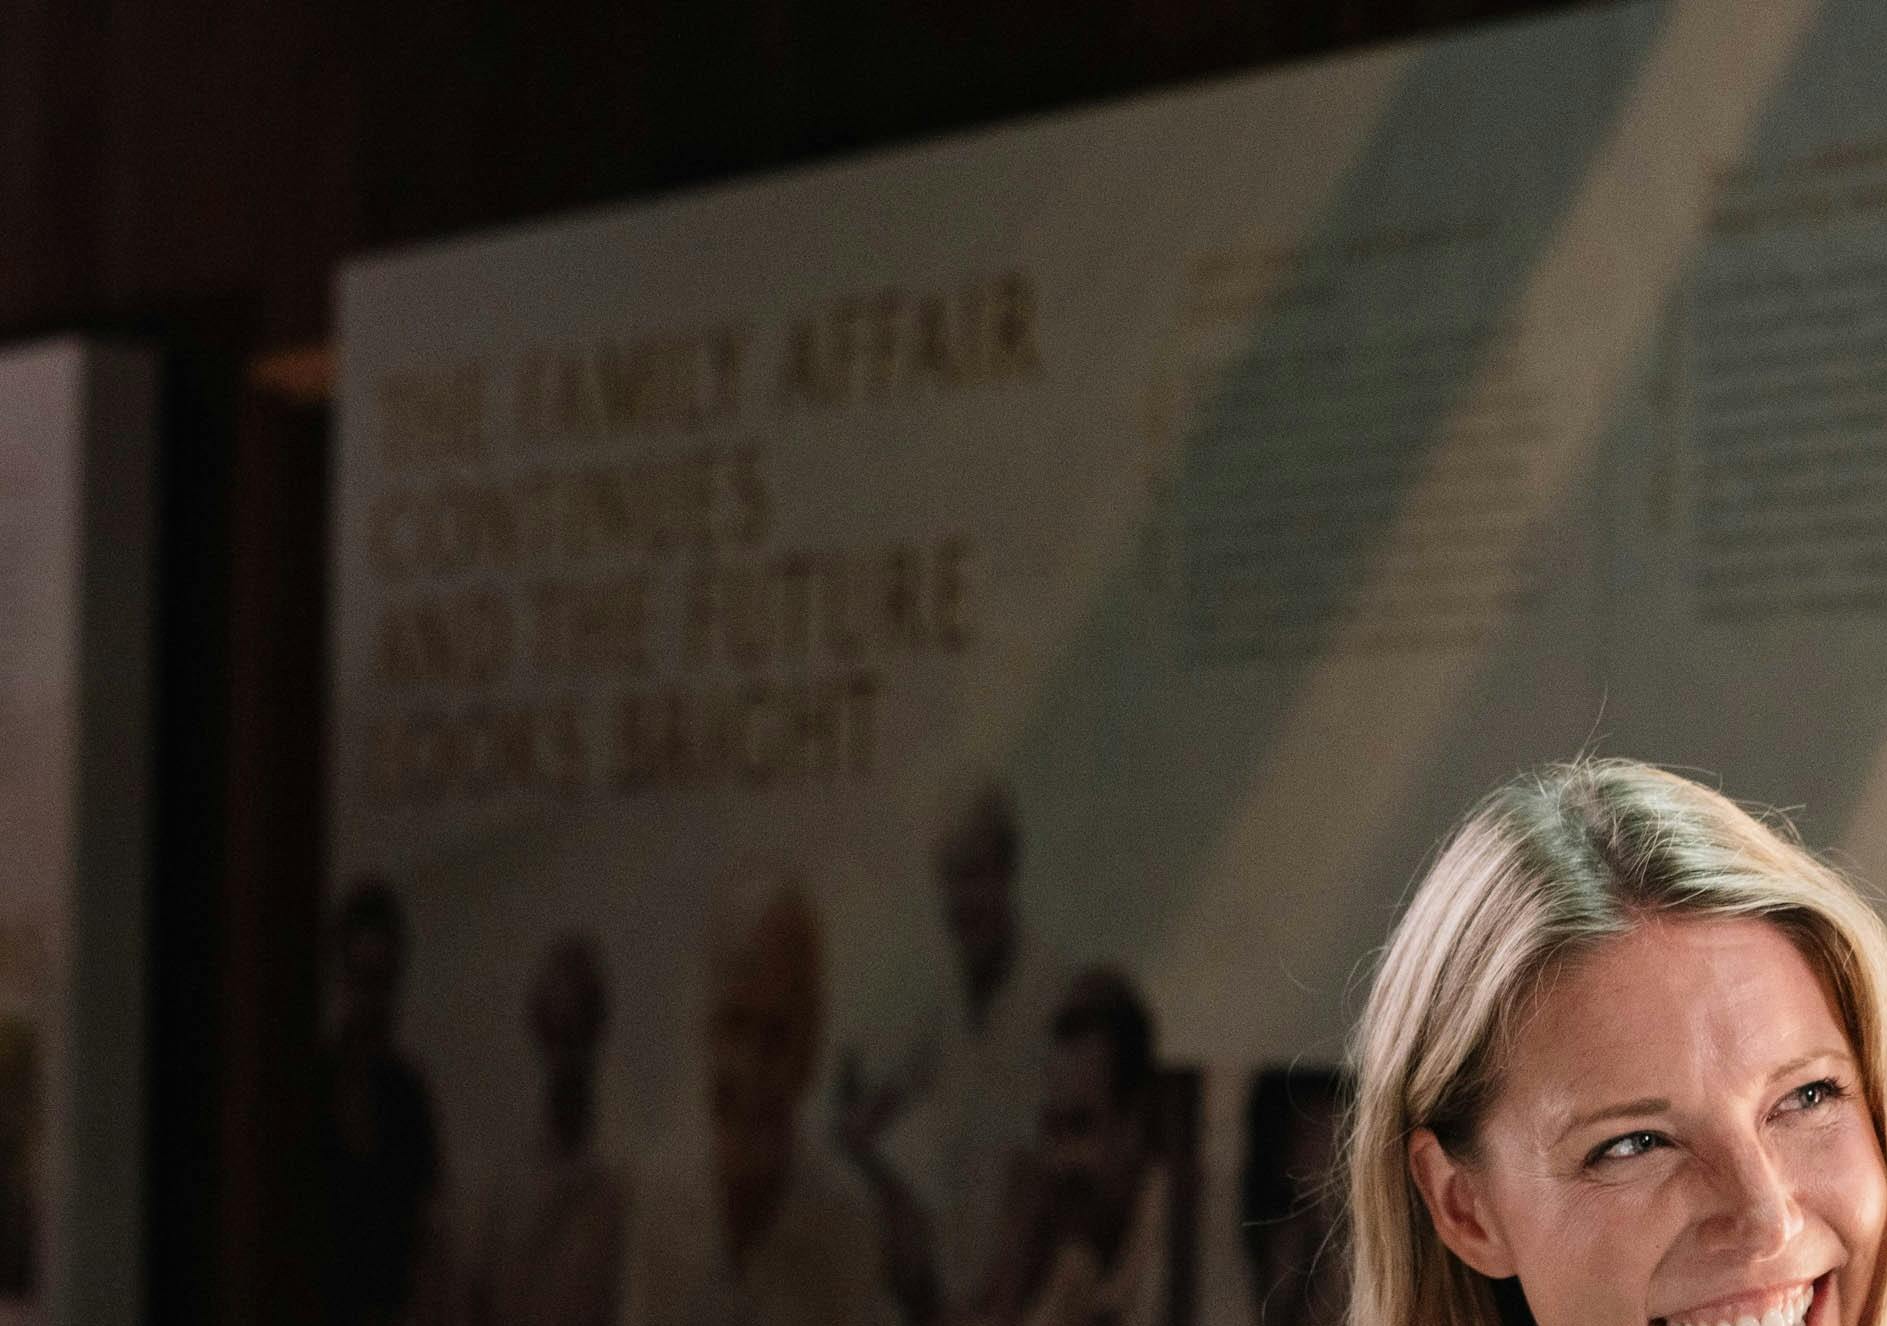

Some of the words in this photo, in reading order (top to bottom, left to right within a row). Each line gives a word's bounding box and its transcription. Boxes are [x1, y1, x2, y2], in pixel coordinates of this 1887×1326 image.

[512, 318, 750, 444] FAMILY
[774, 267, 1046, 412] AFFAIR
[366, 440, 776, 586] CONTINUES
[374, 582, 516, 692] AND
[527, 570, 652, 680] THE
[680, 534, 974, 676] FUTURE
[612, 668, 886, 799] BRIGHT
